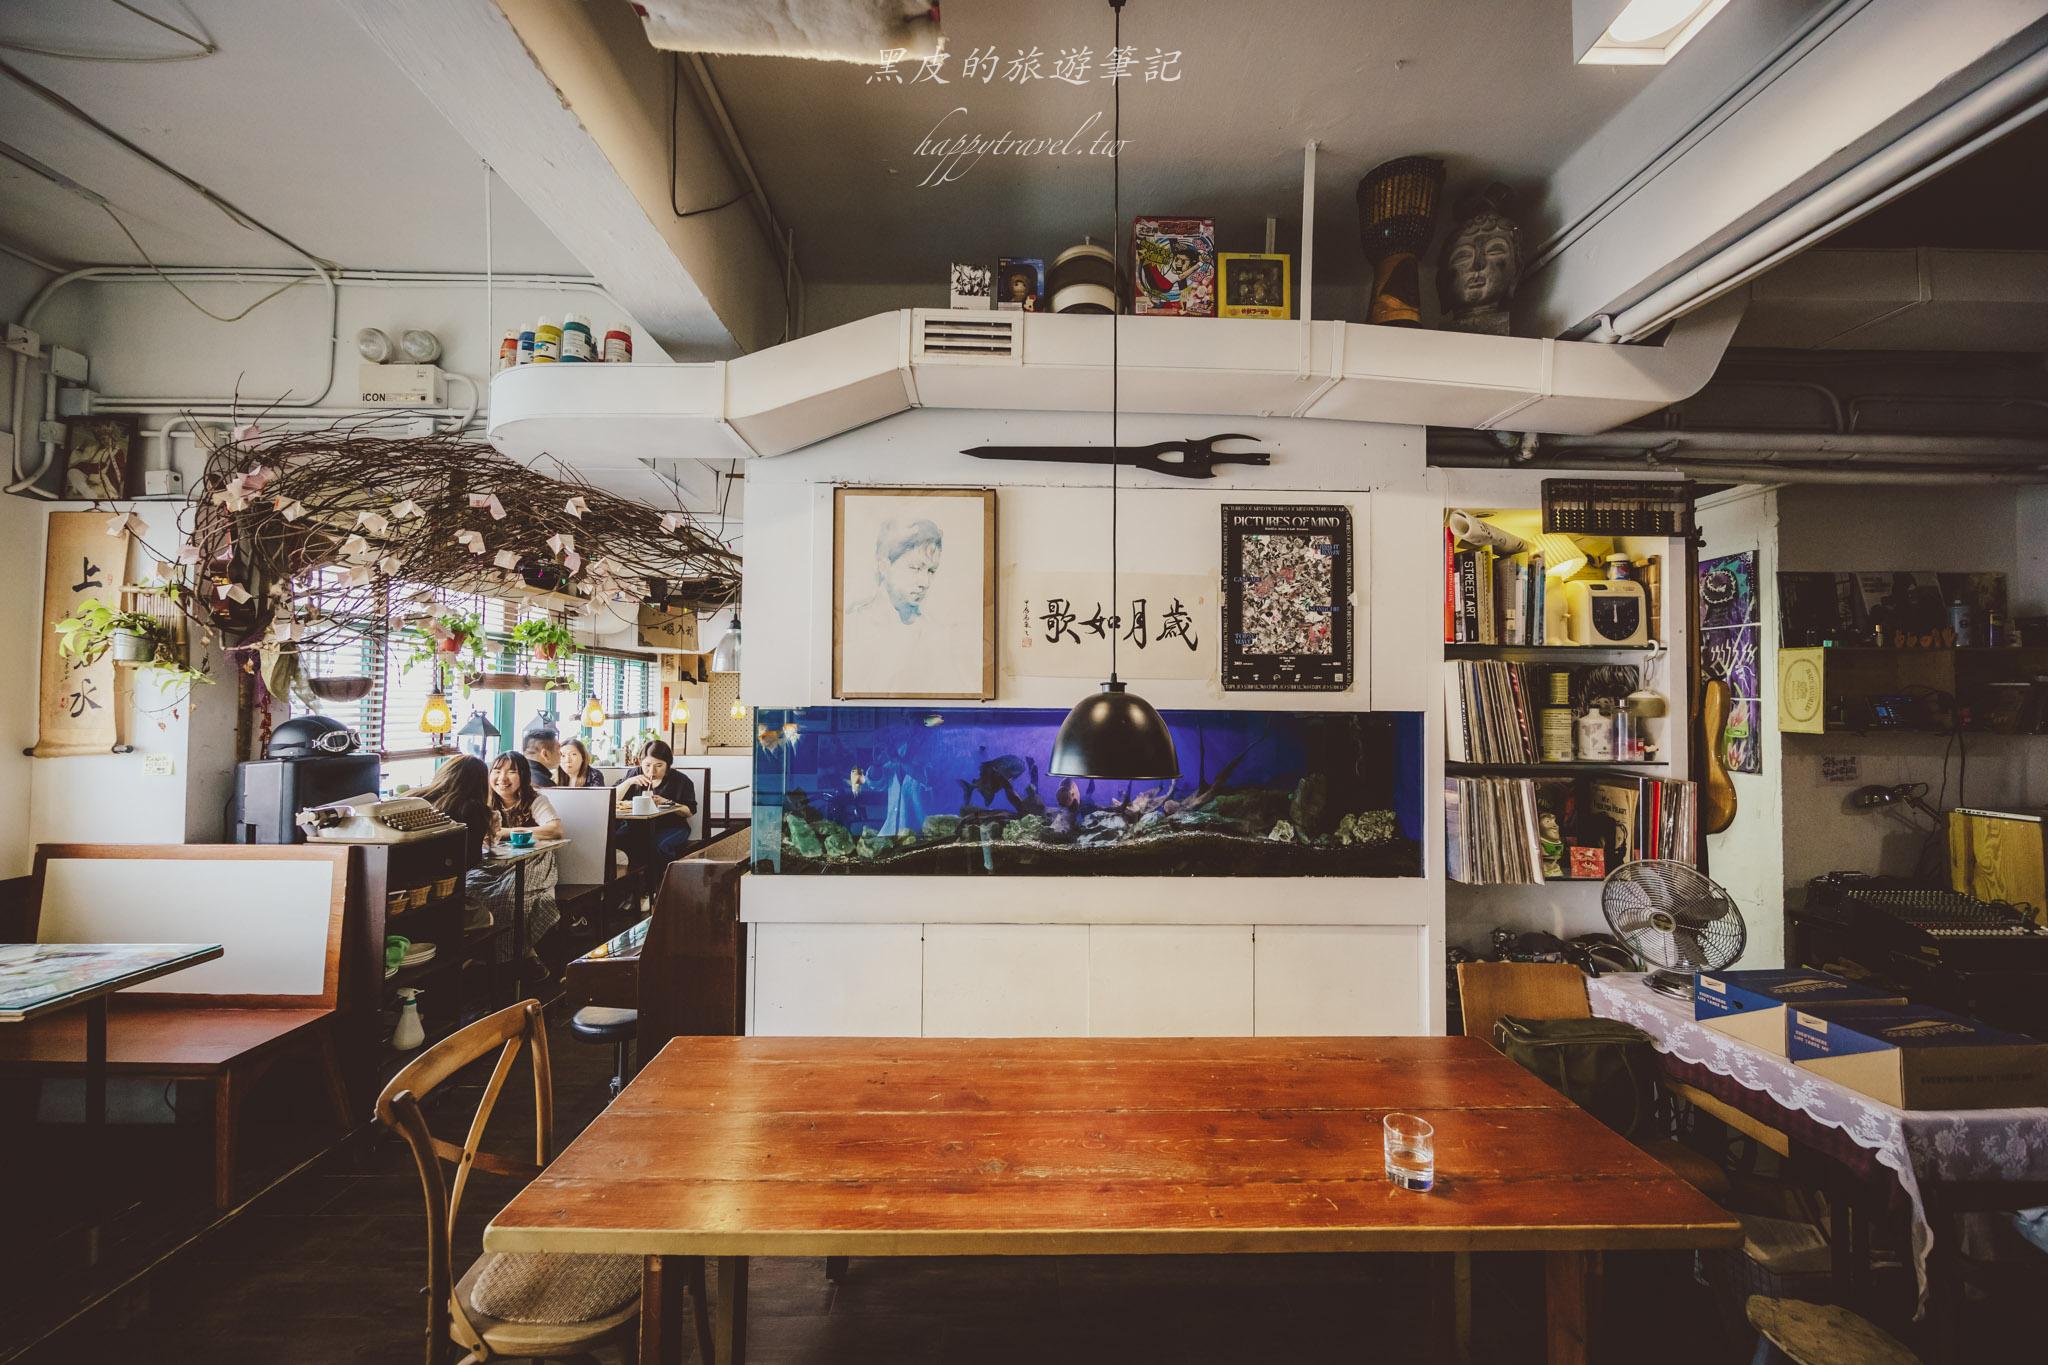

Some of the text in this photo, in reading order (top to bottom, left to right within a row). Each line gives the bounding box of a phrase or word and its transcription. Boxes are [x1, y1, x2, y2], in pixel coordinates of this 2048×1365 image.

[1233, 515, 1340, 528] PICTURES OF MIND
[1464, 561, 1476, 619] STREET ART
[70, 556, 103, 719] 上水
